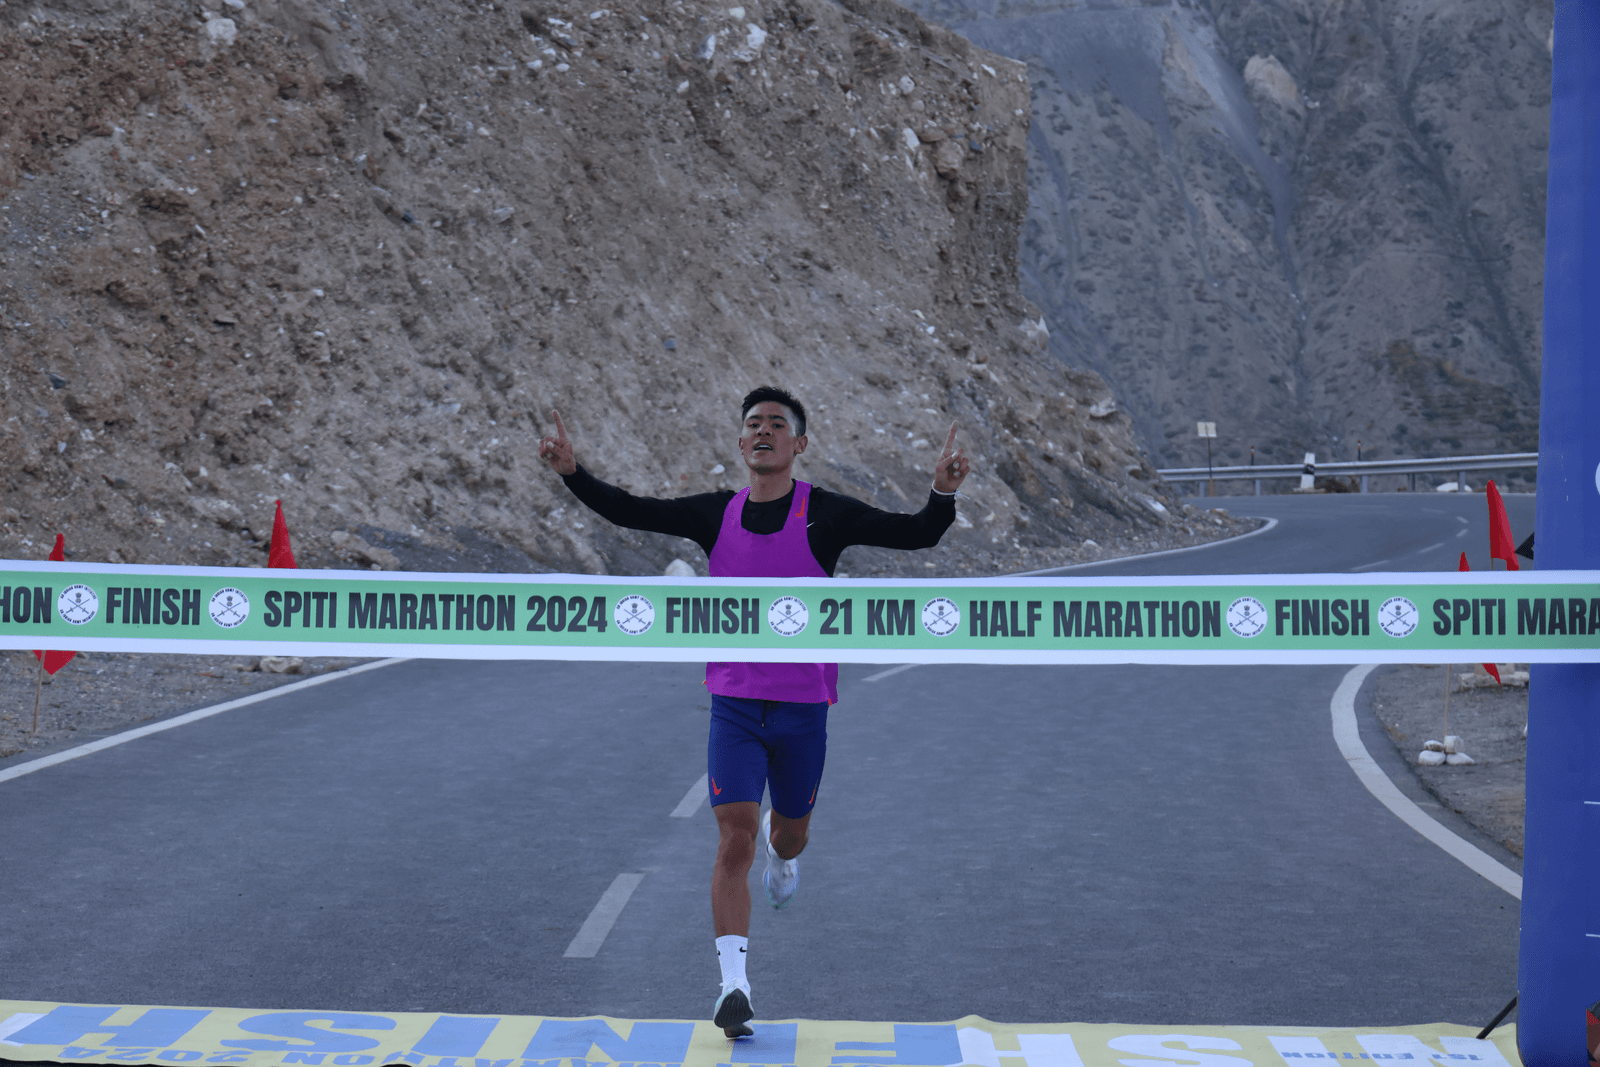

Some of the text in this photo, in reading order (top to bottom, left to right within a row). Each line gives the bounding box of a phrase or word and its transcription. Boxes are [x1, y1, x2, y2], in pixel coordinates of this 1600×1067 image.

[105, 586, 201, 626] FINISH
[263, 590, 608, 633] SPITI MARATHON 2024
[665, 597, 760, 635] FINISH
[819, 598, 916, 636] 21 KM
[969, 600, 1221, 638] HALF MARATHON
[1275, 598, 1370, 636] FINISH
[1432, 598, 1507, 636] SPITI
[3, 1005, 963, 1066] FINISH
[57, 1046, 254, 1063] 2024
